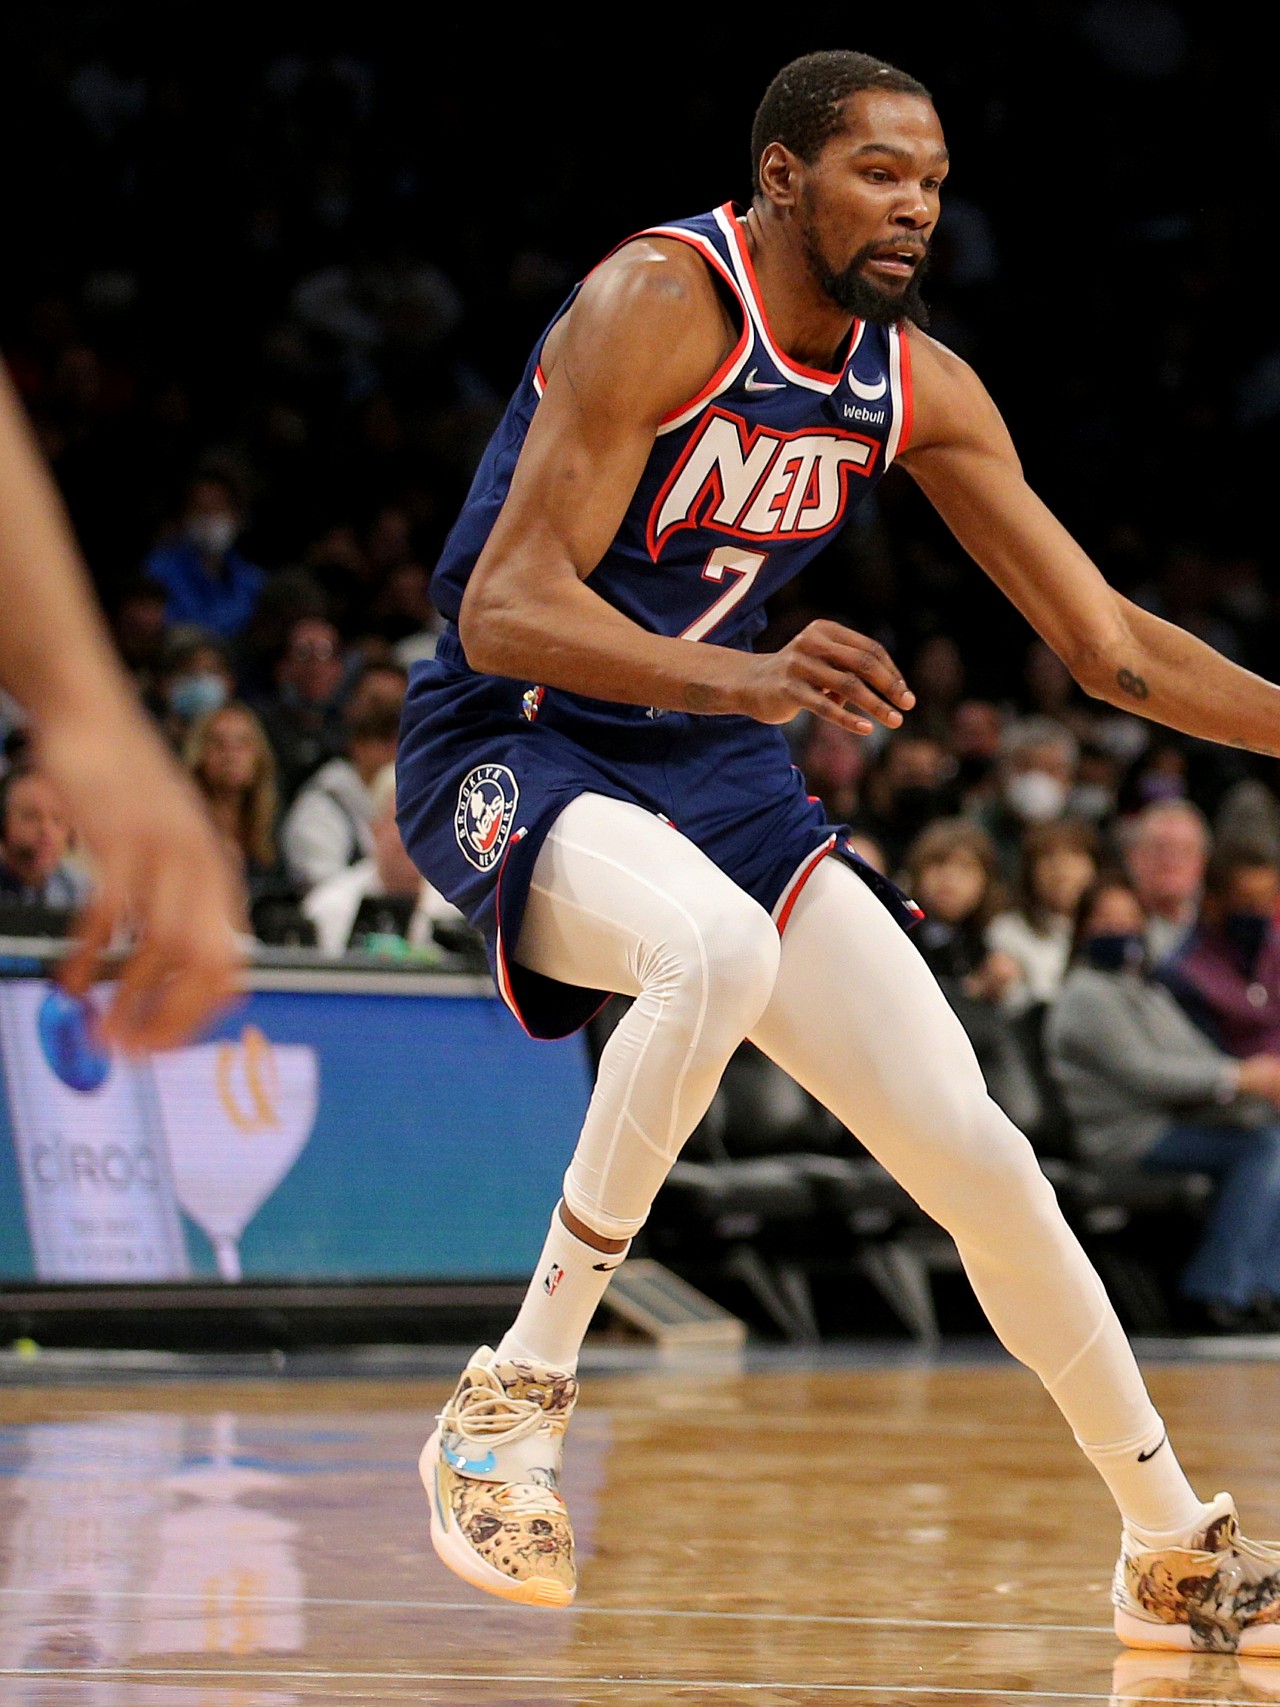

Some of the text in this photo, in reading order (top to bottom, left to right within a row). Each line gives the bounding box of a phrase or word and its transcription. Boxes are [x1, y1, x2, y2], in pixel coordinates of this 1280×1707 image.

[843, 404, 885, 424] Webull
[646, 405, 881, 563] NETS
[677, 545, 769, 642] 7
[458, 767, 502, 839] BROOKLYN
[479, 800, 513, 866] NEW YORK
